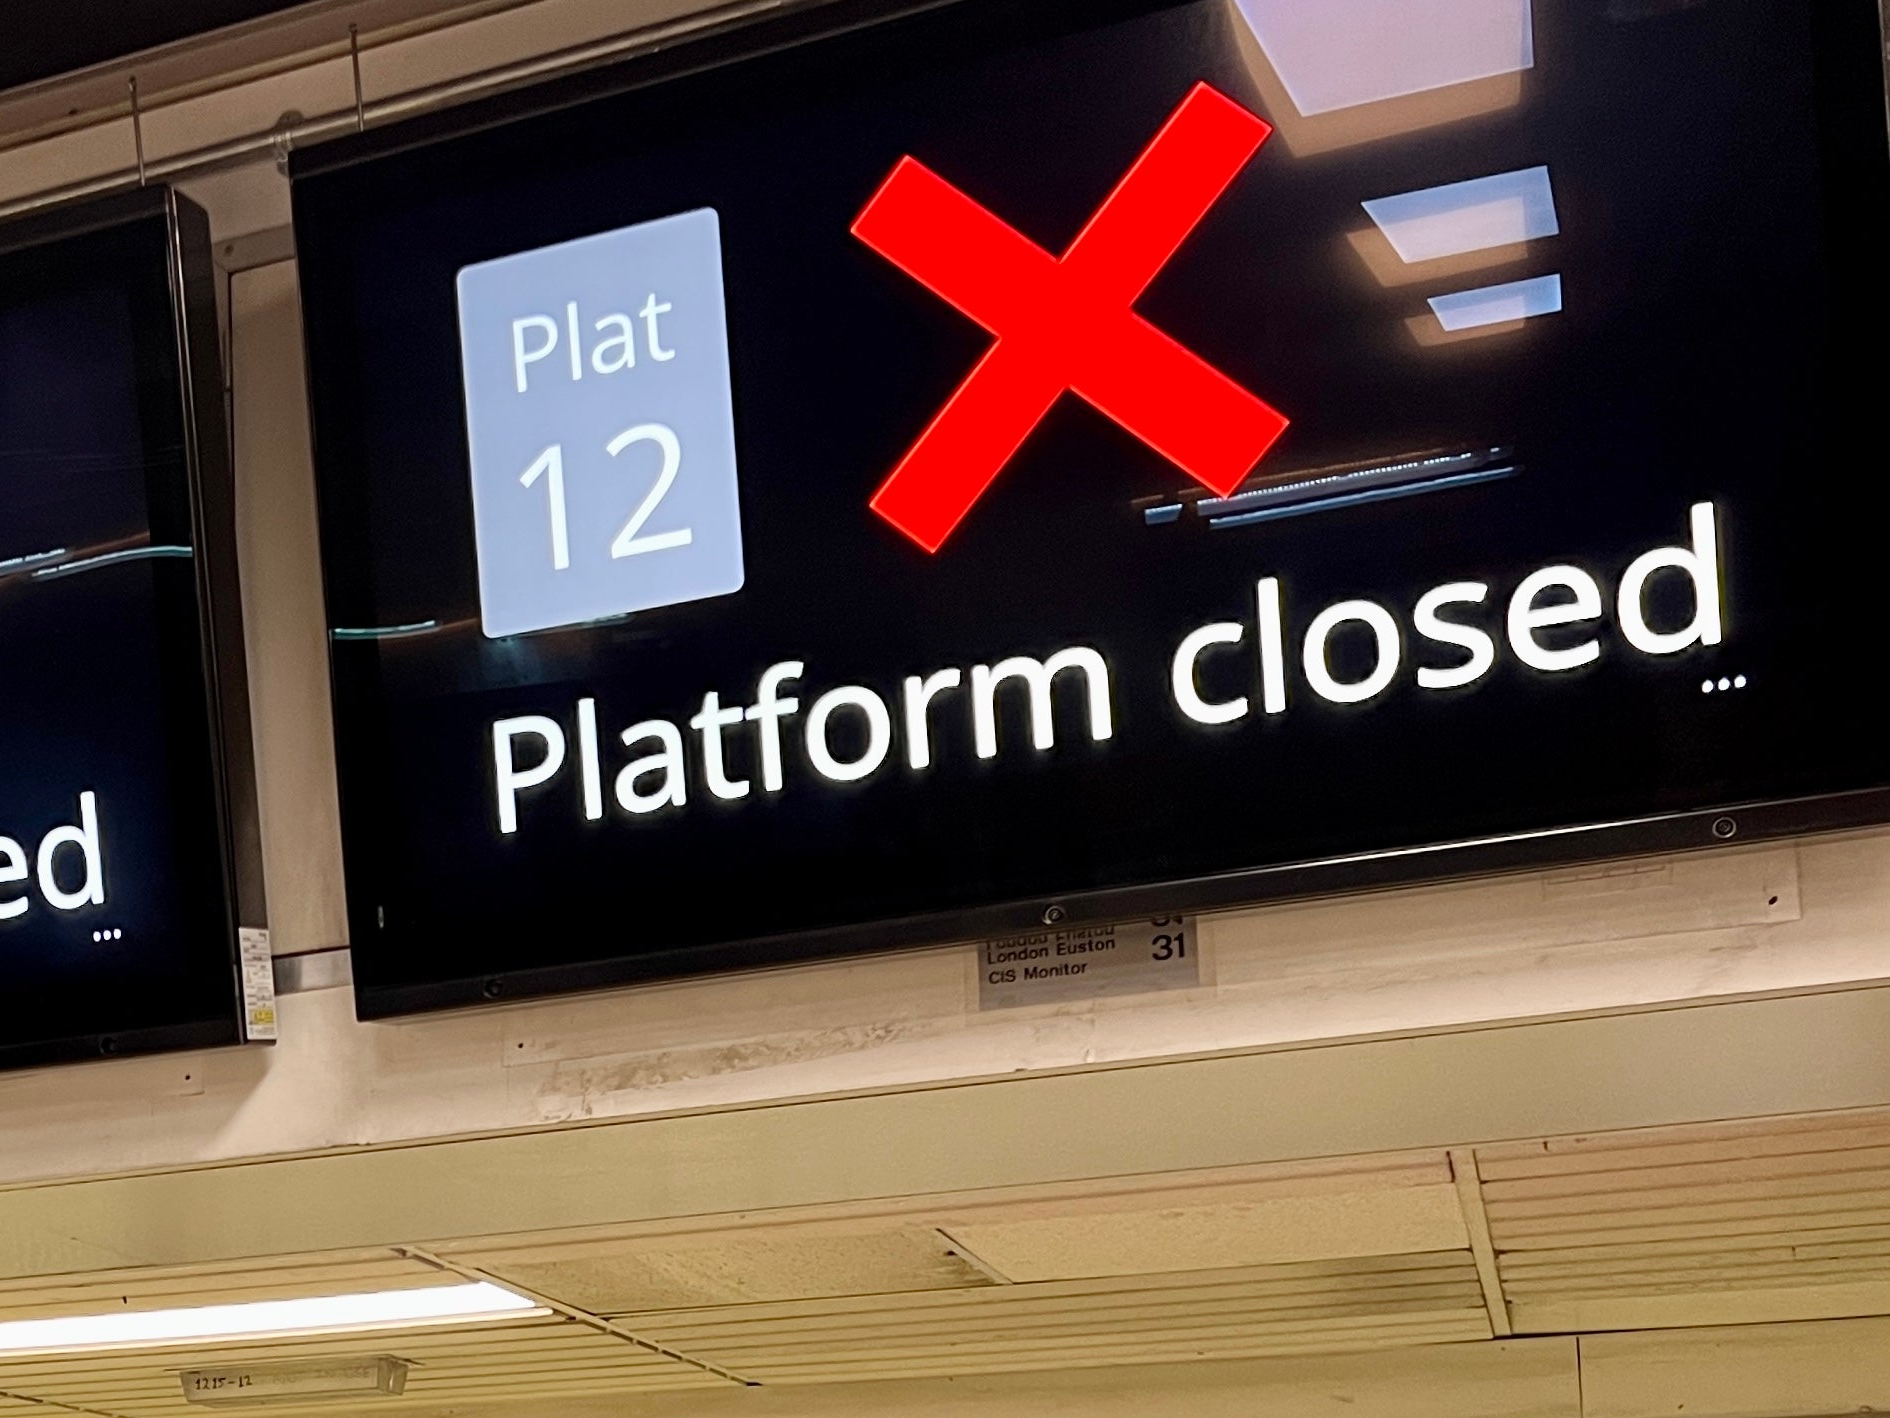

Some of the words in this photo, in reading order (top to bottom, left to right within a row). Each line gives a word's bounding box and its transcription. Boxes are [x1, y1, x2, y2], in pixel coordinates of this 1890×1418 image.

[511, 292, 676, 393] Plat
[520, 424, 693, 570] 12
[491, 660, 1113, 834] Platform
[1170, 501, 1724, 727] closed
[987, 946, 1049, 965] London
[1056, 938, 1116, 957] Euston
[1151, 932, 1185, 961] 31
[988, 969, 1016, 985] CIS
[1023, 962, 1088, 981] Monitor
